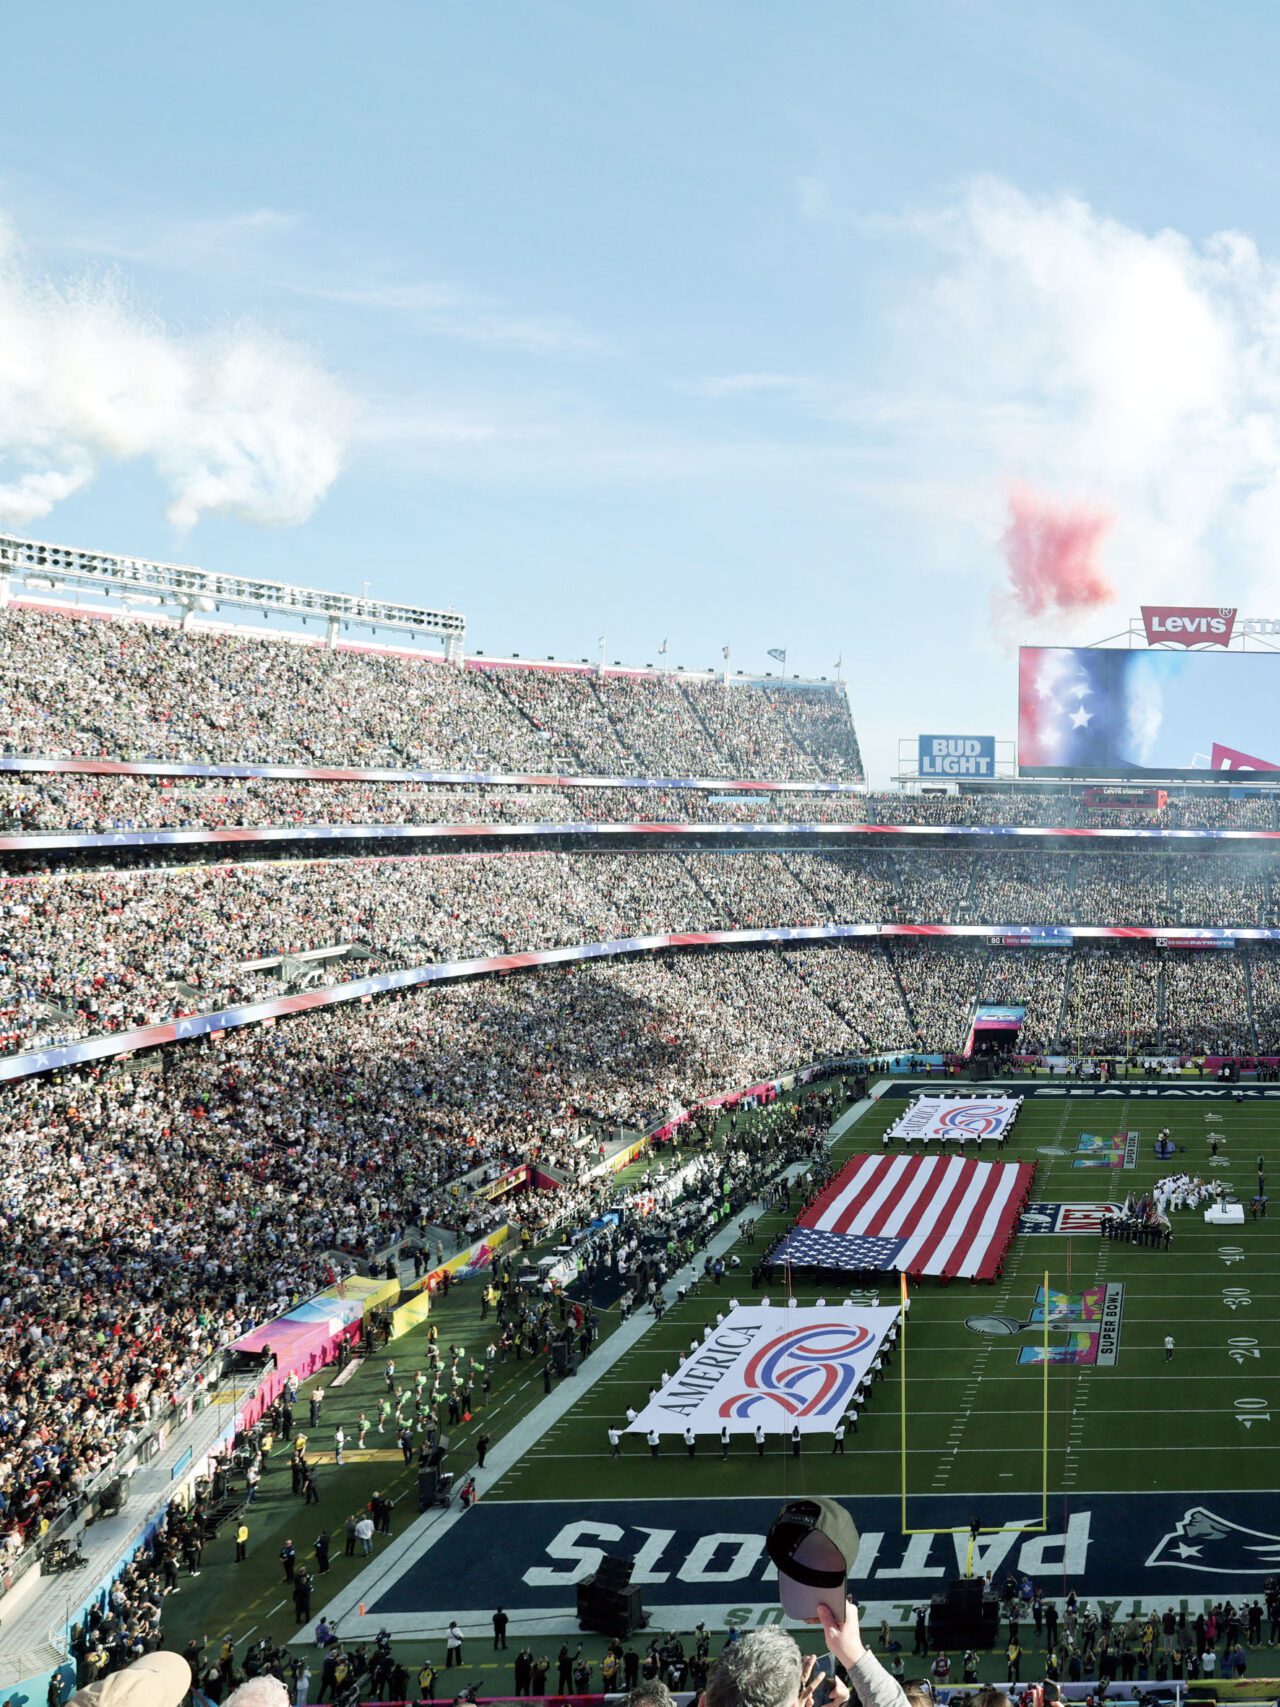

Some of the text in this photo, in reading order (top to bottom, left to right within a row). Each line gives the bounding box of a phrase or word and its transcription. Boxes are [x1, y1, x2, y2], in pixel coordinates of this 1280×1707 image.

[932, 739, 982, 756] BUD
[922, 756, 991, 774] LIGHT
[1217, 1246, 1245, 1263] 40
[1222, 1288, 1252, 1306] 30
[1101, 1291, 1120, 1355] SUPER BOWL
[1227, 1337, 1261, 1359] 20
[657, 1324, 763, 1417] AMERICA
[718, 1323, 876, 1418] 250
[1234, 1398, 1271, 1422] 10
[522, 1511, 1094, 1586] PATOTS
